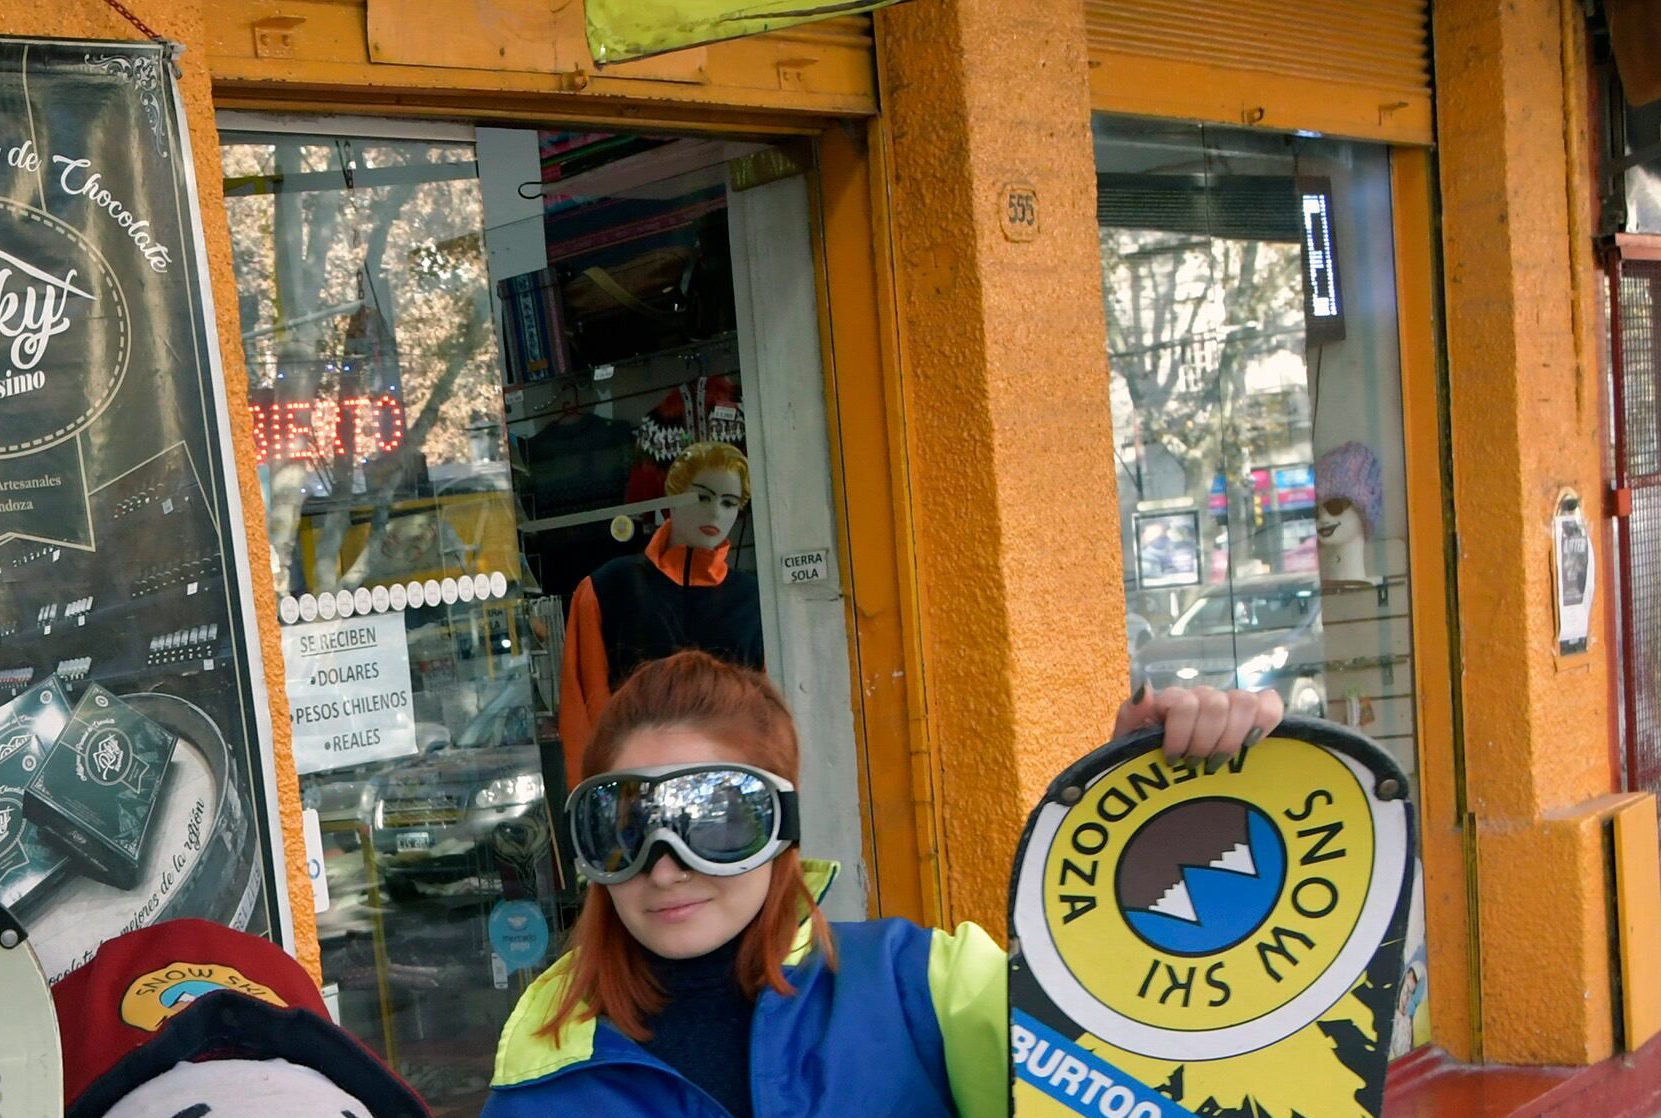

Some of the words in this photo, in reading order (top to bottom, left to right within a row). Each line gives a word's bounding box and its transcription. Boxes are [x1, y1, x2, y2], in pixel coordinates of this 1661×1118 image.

[7, 139, 42, 173] de
[52, 153, 172, 275] Chocolate
[1008, 193, 1035, 226] 555
[784, 552, 823, 568] CIERRA
[791, 567, 819, 582] SOLA
[300, 634, 317, 654] SE
[320, 626, 377, 651] RECIBEN
[317, 661, 380, 687] DOLARES
[295, 701, 340, 725] PESOS
[343, 690, 408, 717] CHILENOS
[333, 728, 381, 753] REALES
[161, 870, 175, 896] de
[175, 855, 188, 874] la
[184, 798, 207, 853] región
[1257, 788, 1347, 984] SNOW
[136, 967, 214, 998] SNOW
[227, 974, 268, 1000] SKI
[1137, 958, 1232, 1008] SKI
